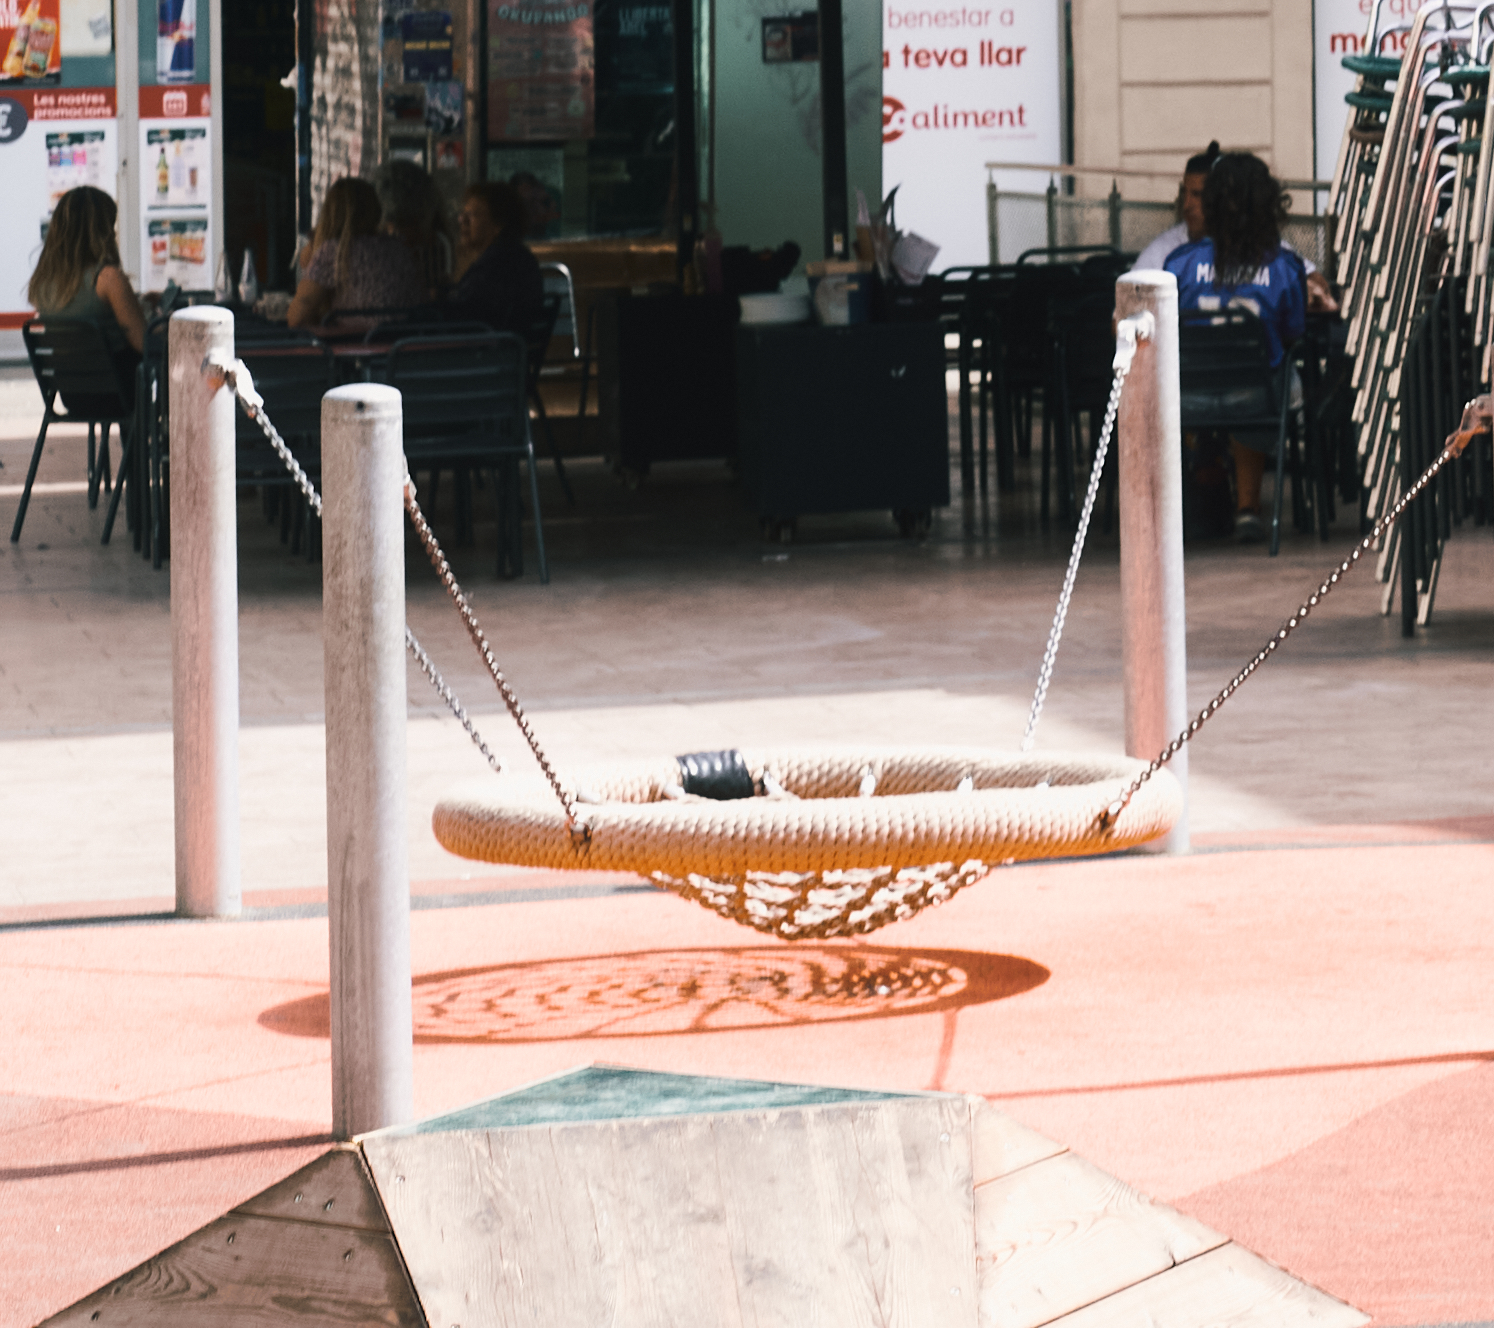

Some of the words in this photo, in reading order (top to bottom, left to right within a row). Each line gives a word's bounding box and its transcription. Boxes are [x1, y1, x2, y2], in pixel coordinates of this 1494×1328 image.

[888, 5, 991, 29] benestar
[901, 43, 968, 69] teva
[979, 39, 1027, 67] llar
[911, 103, 1027, 131] aliment
